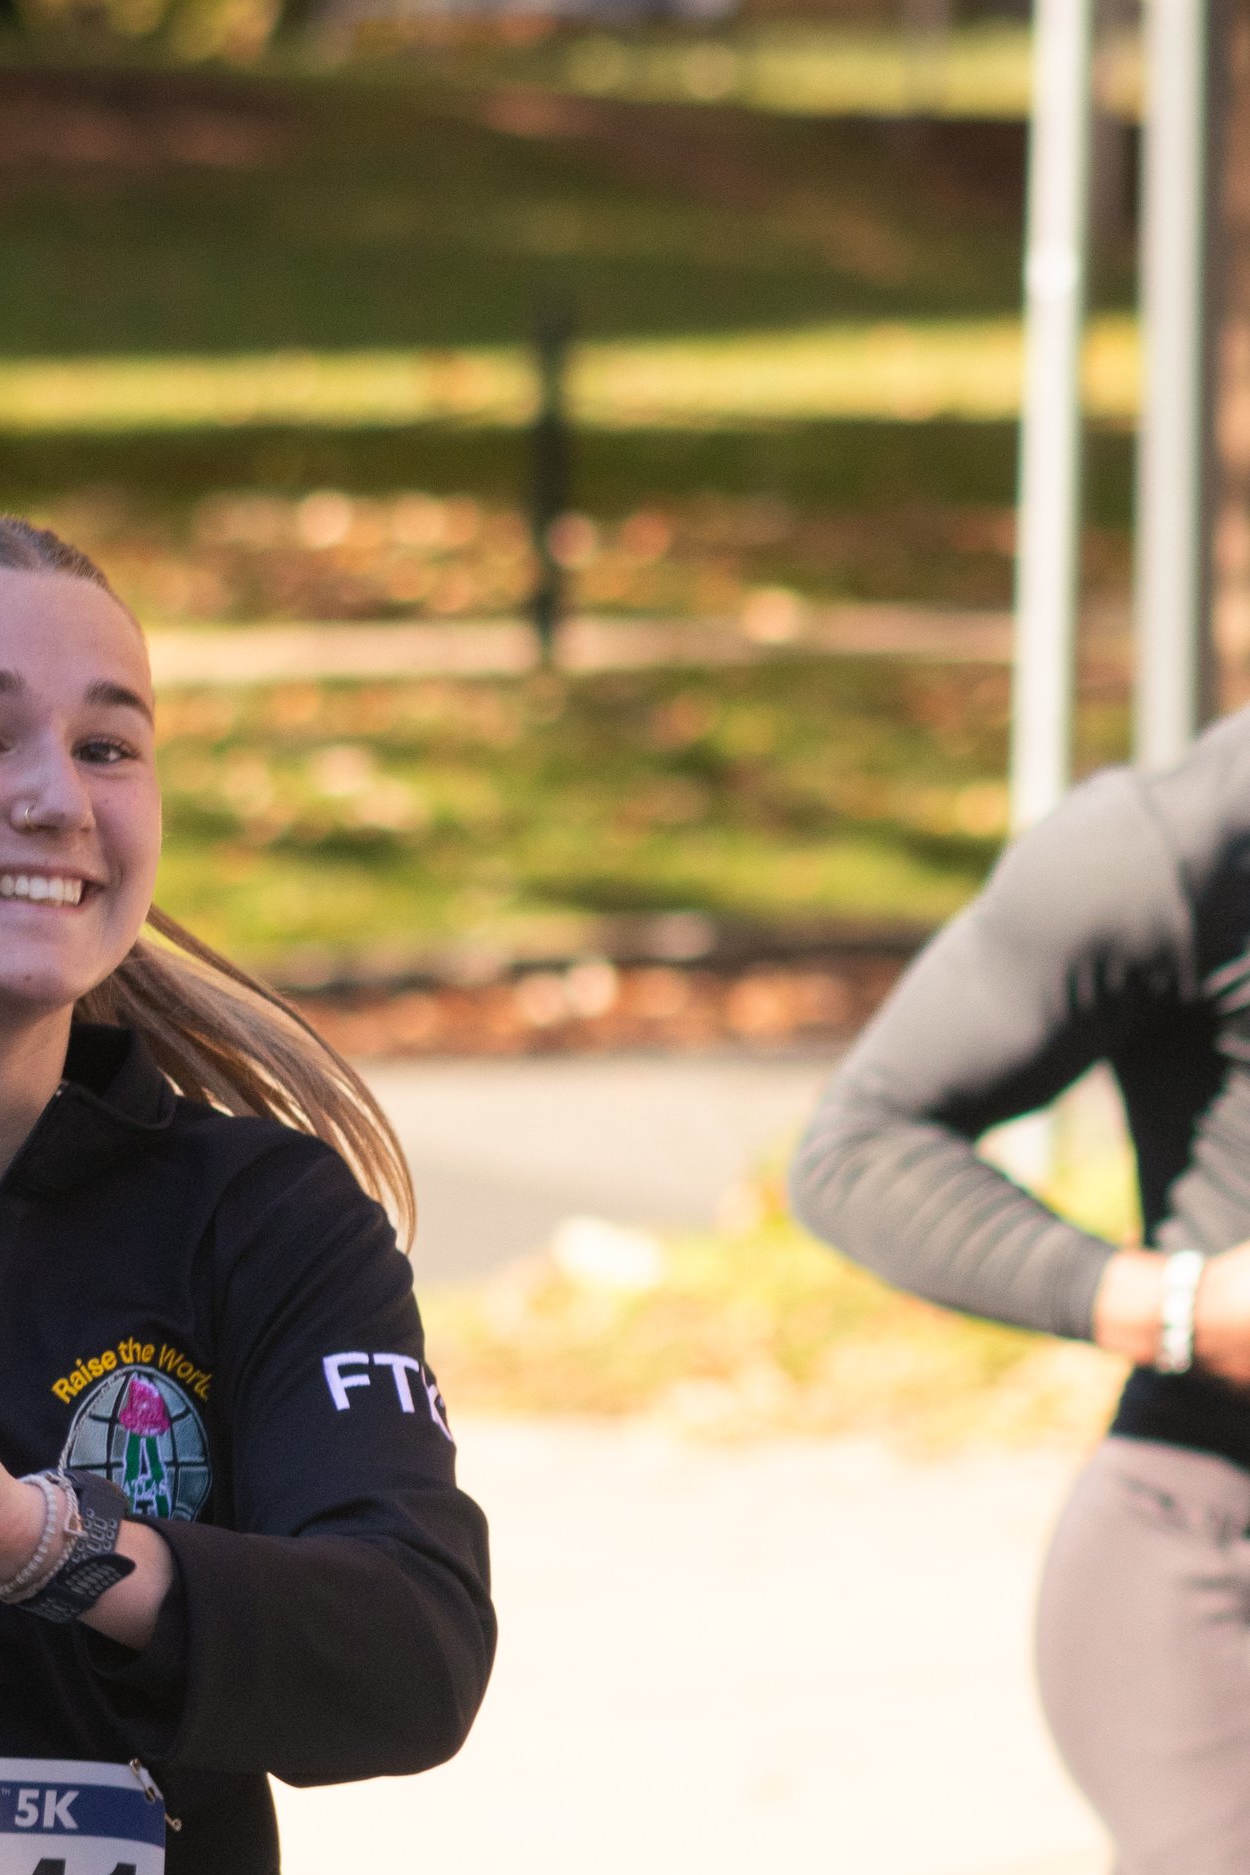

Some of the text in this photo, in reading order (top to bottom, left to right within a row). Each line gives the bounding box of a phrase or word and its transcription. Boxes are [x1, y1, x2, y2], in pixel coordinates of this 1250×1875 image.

[51, 1350, 118, 1404] Raise
[118, 1336, 155, 1364] the
[14, 1788, 80, 1830] 5K
